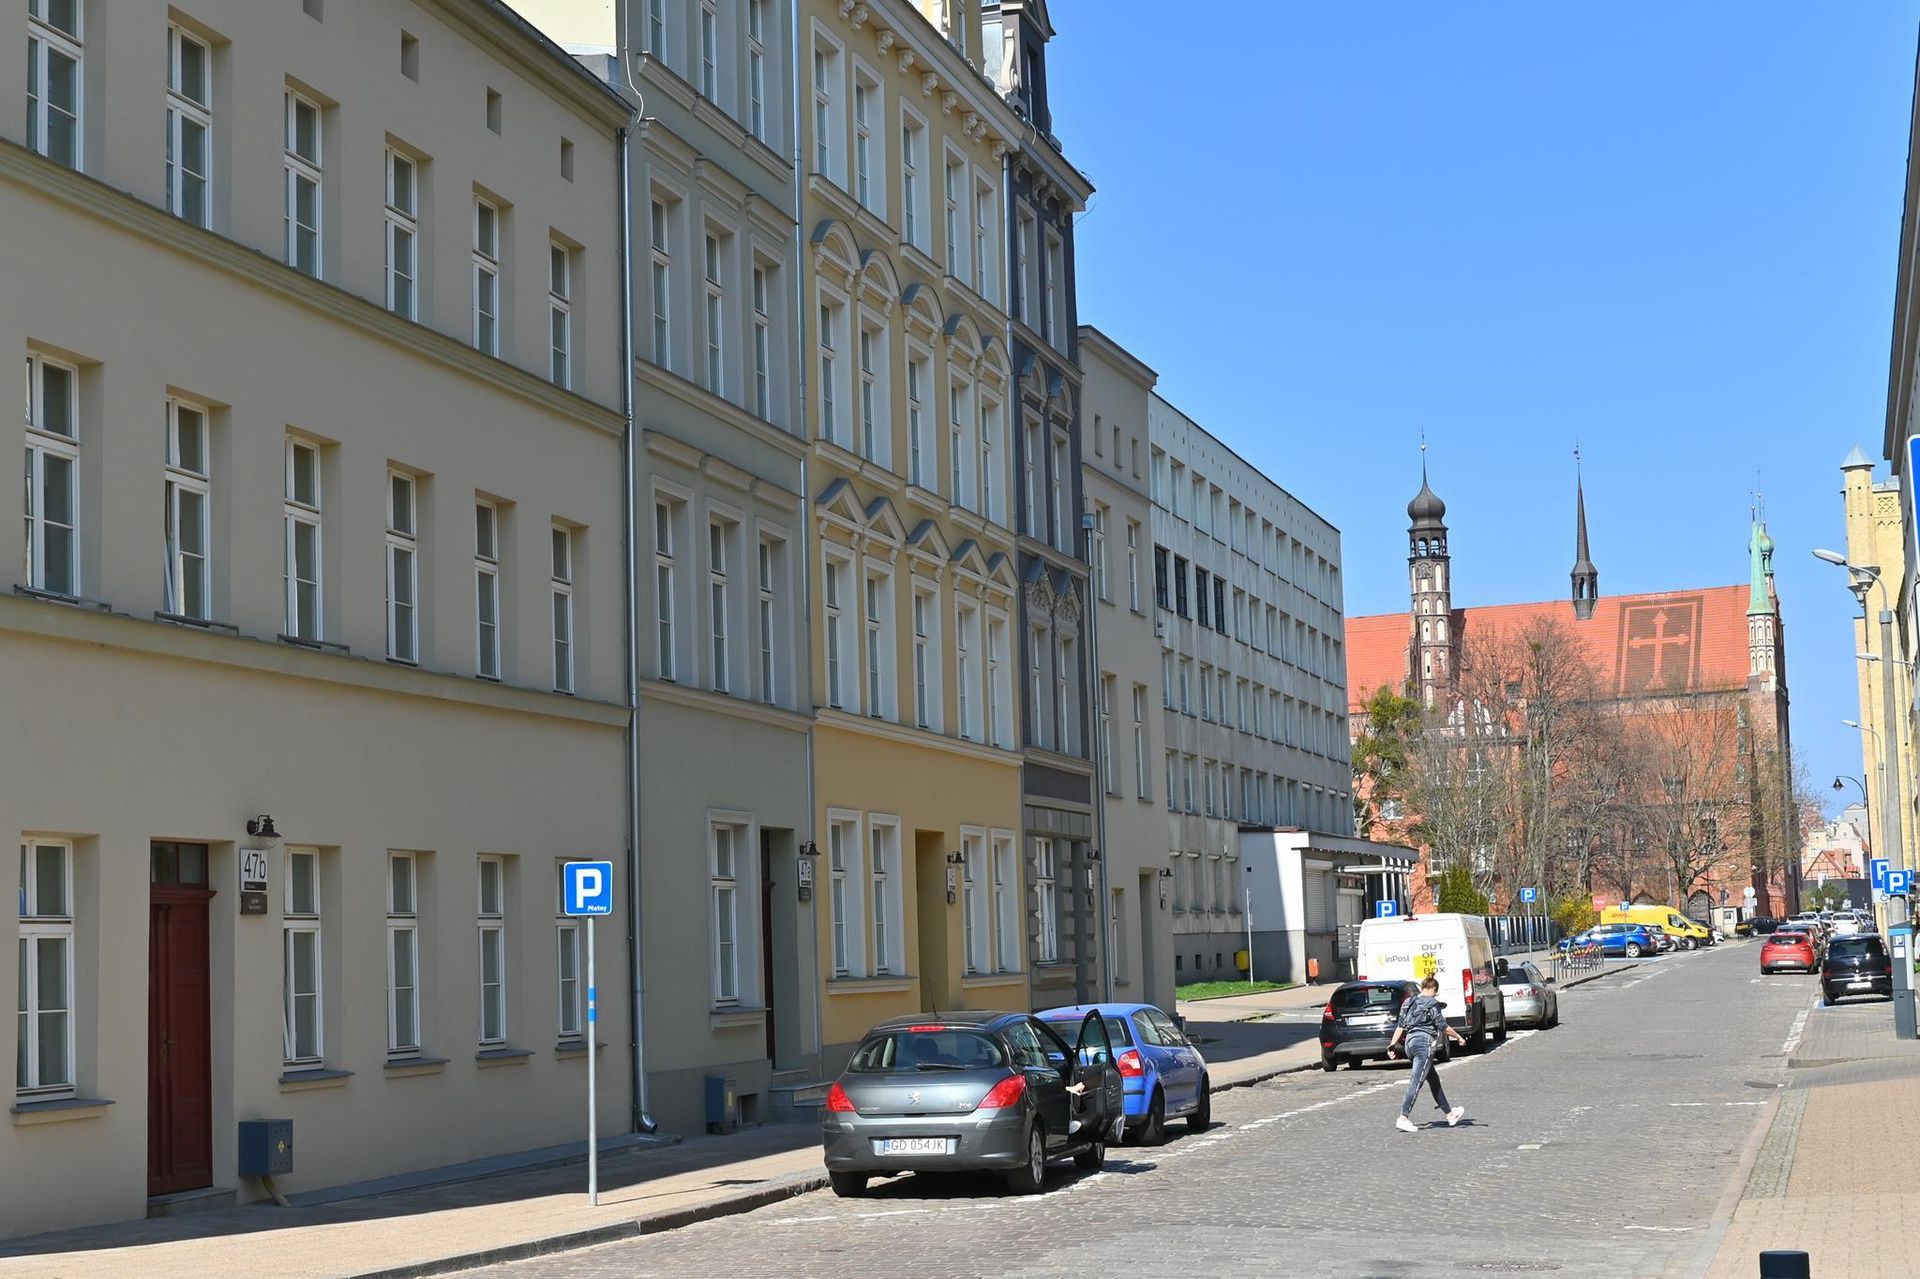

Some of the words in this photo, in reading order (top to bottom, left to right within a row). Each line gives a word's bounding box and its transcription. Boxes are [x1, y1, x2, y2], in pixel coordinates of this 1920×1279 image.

[244, 852, 267, 879] 47b
[801, 862, 811, 879] 47a
[576, 868, 602, 908] P
[1889, 872, 1904, 892] P
[1524, 889, 1532, 900] P
[1381, 903, 1392, 917] P
[1421, 943, 1443, 951] OUT
[1423, 967, 1446, 975] BOX
[891, 1139, 907, 1151] GD
[910, 1139, 944, 1151] 054JK
